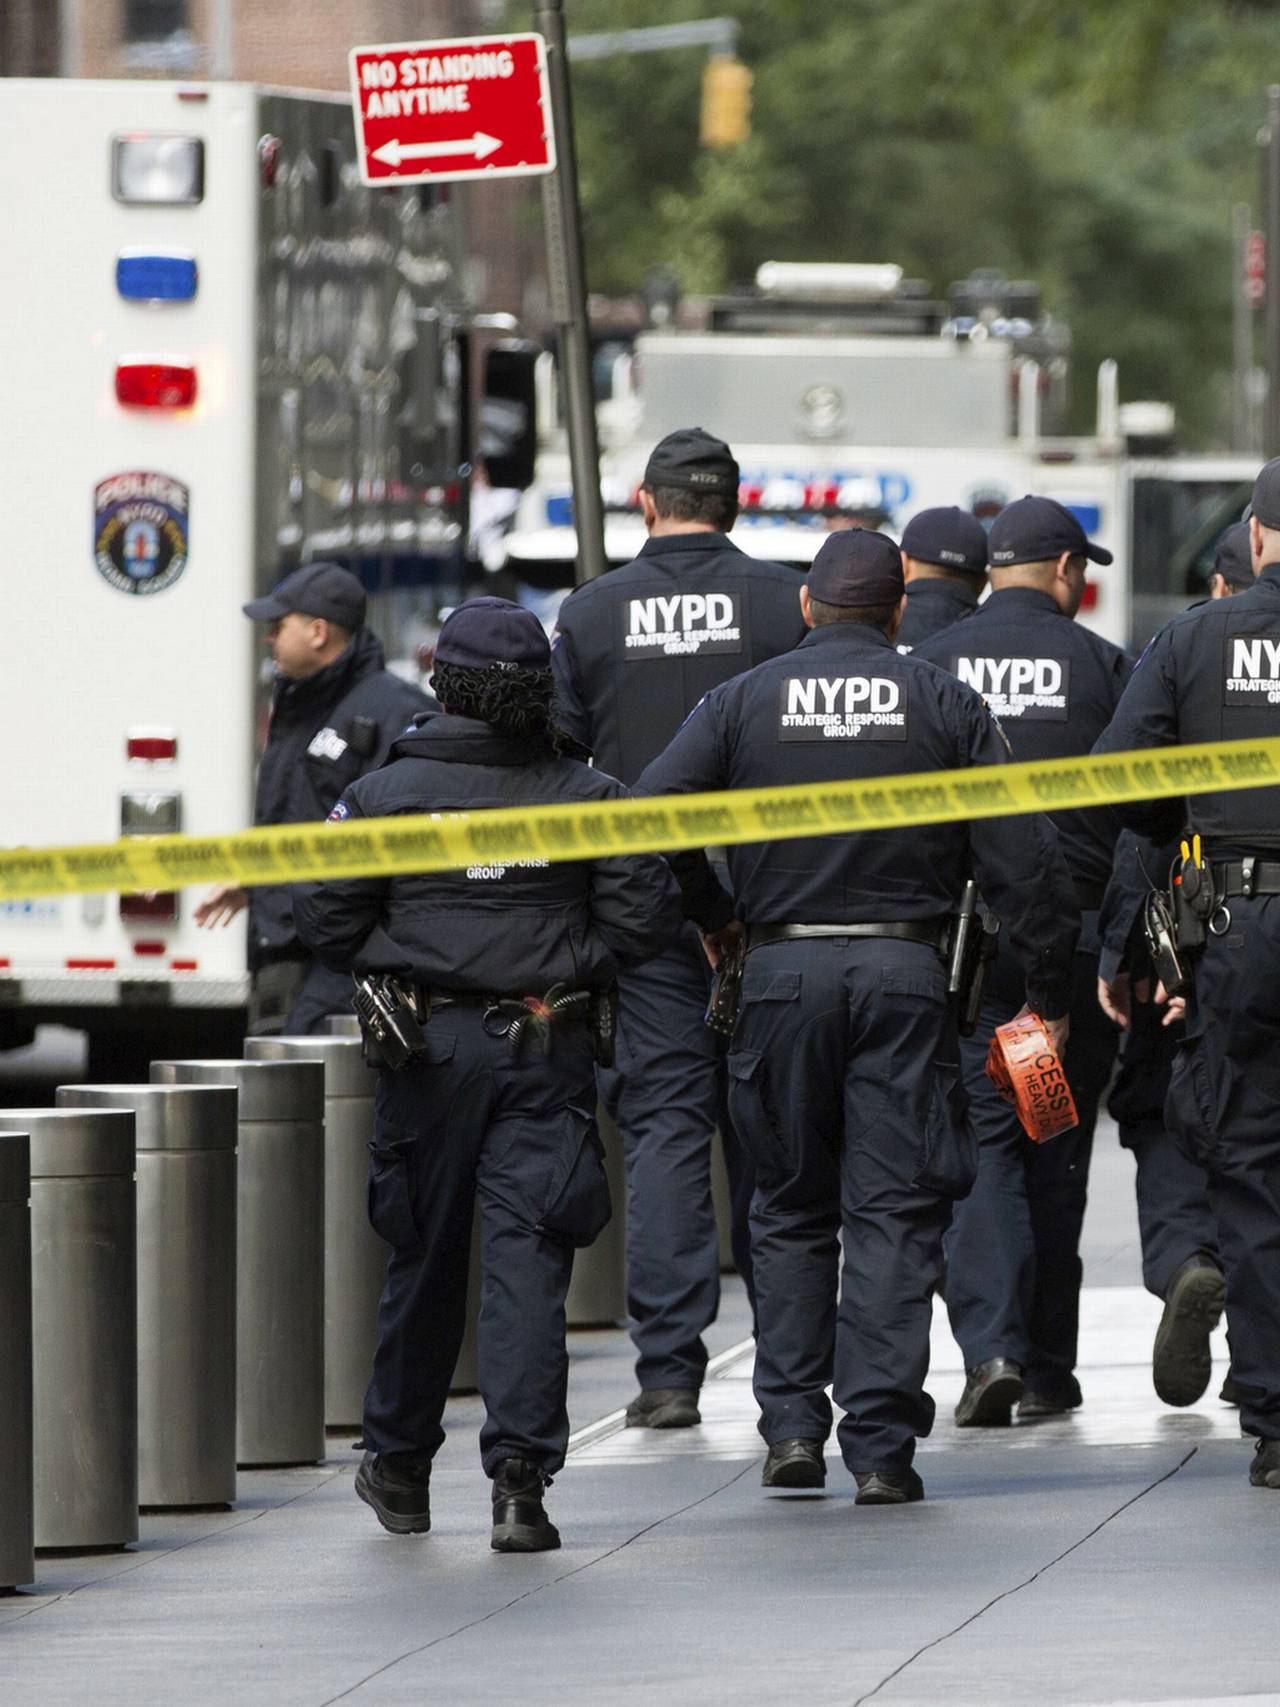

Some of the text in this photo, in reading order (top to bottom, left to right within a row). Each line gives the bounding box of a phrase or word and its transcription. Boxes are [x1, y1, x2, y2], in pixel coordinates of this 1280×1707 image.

[362, 50, 515, 90] NO STANDING
[367, 84, 471, 119] ANYTIME
[630, 593, 734, 636] NYPD
[625, 627, 741, 648] STRATEGIC RESPONSE
[957, 657, 1062, 696] NYPD
[788, 676, 900, 713] NYPD
[782, 713, 905, 726] STRATEGIC RESPONSE
[823, 725, 862, 737] GROUP
[466, 866, 506, 880] GROUP
